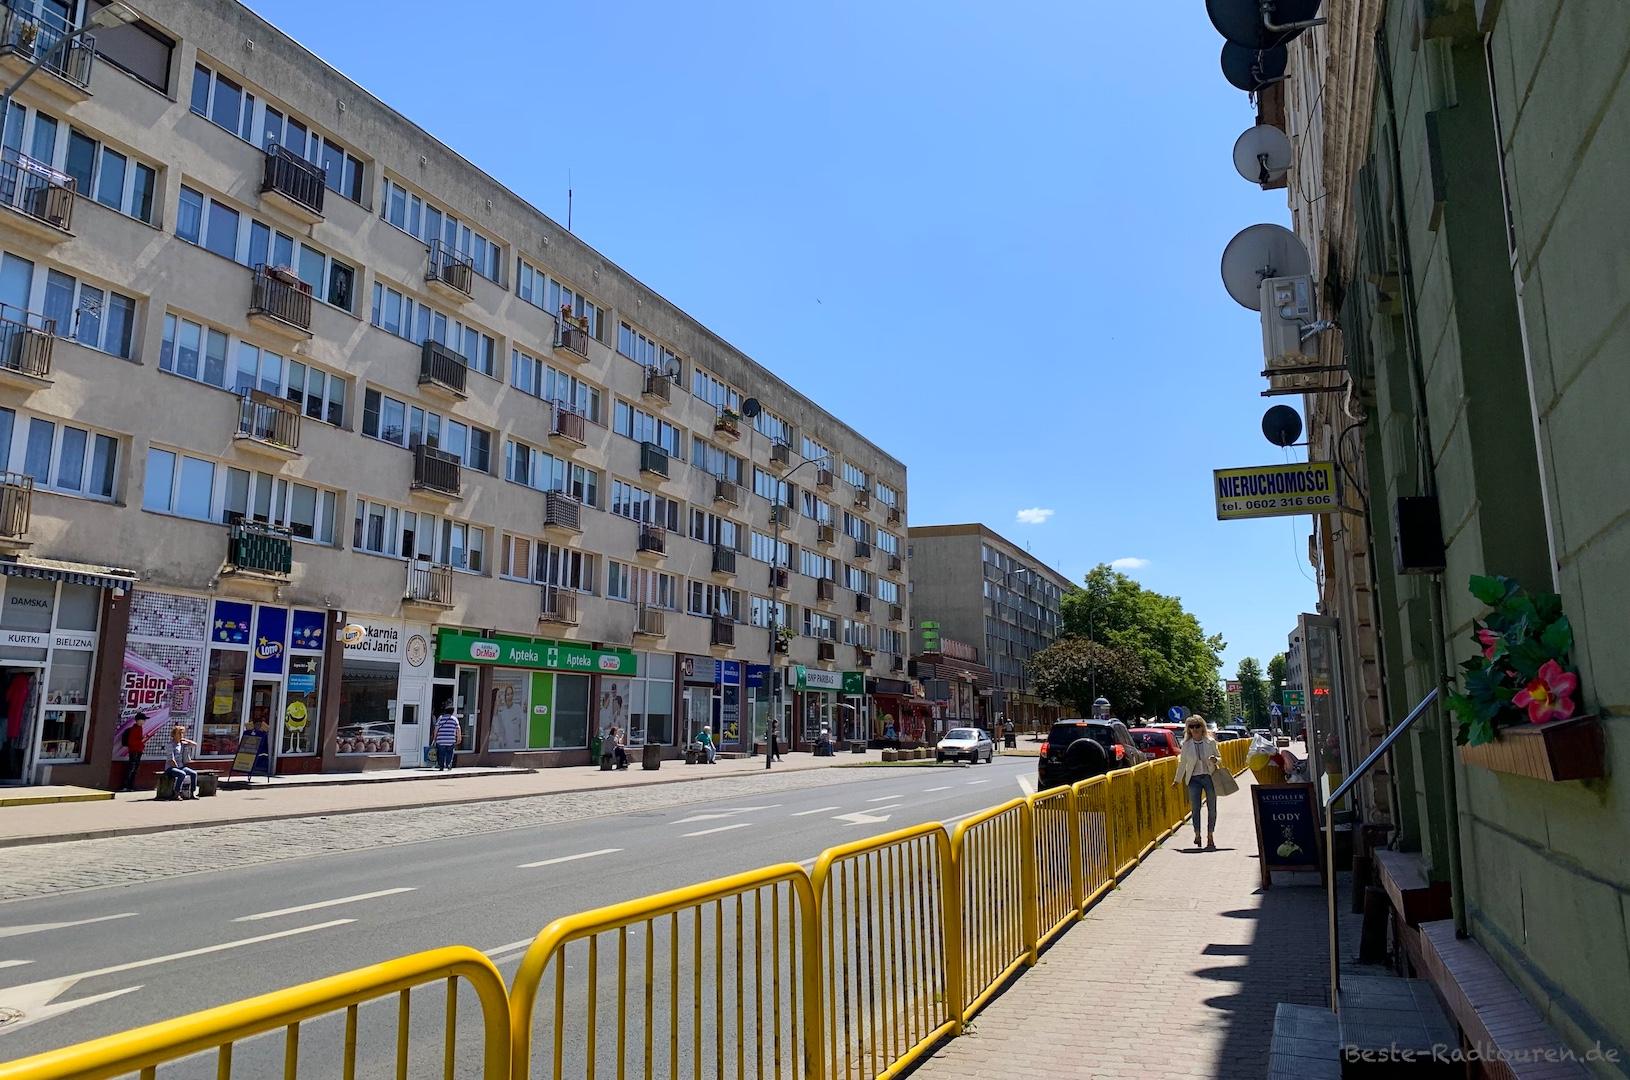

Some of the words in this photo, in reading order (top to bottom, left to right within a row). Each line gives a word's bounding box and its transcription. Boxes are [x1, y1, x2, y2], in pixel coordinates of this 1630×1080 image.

[1218, 466, 1329, 498] NIERUCHOMOŚCI
[1222, 502, 1242, 511] tel.
[1246, 500, 1276, 510] 0602
[1281, 497, 1303, 507] 316
[1307, 495, 1330, 505] 606
[11, 597, 48, 608] DAMSKA
[8, 634, 40, 644] KURTKI
[56, 638, 92, 648] BIELIZNA
[261, 645, 278, 655] LOTTO
[373, 640, 398, 653] Jańci
[509, 648, 539, 662] Apteka
[566, 653, 592, 667] Apteka
[125, 674, 167, 690] Salon
[127, 689, 163, 708] gier
[1272, 813, 1301, 821] LODY
